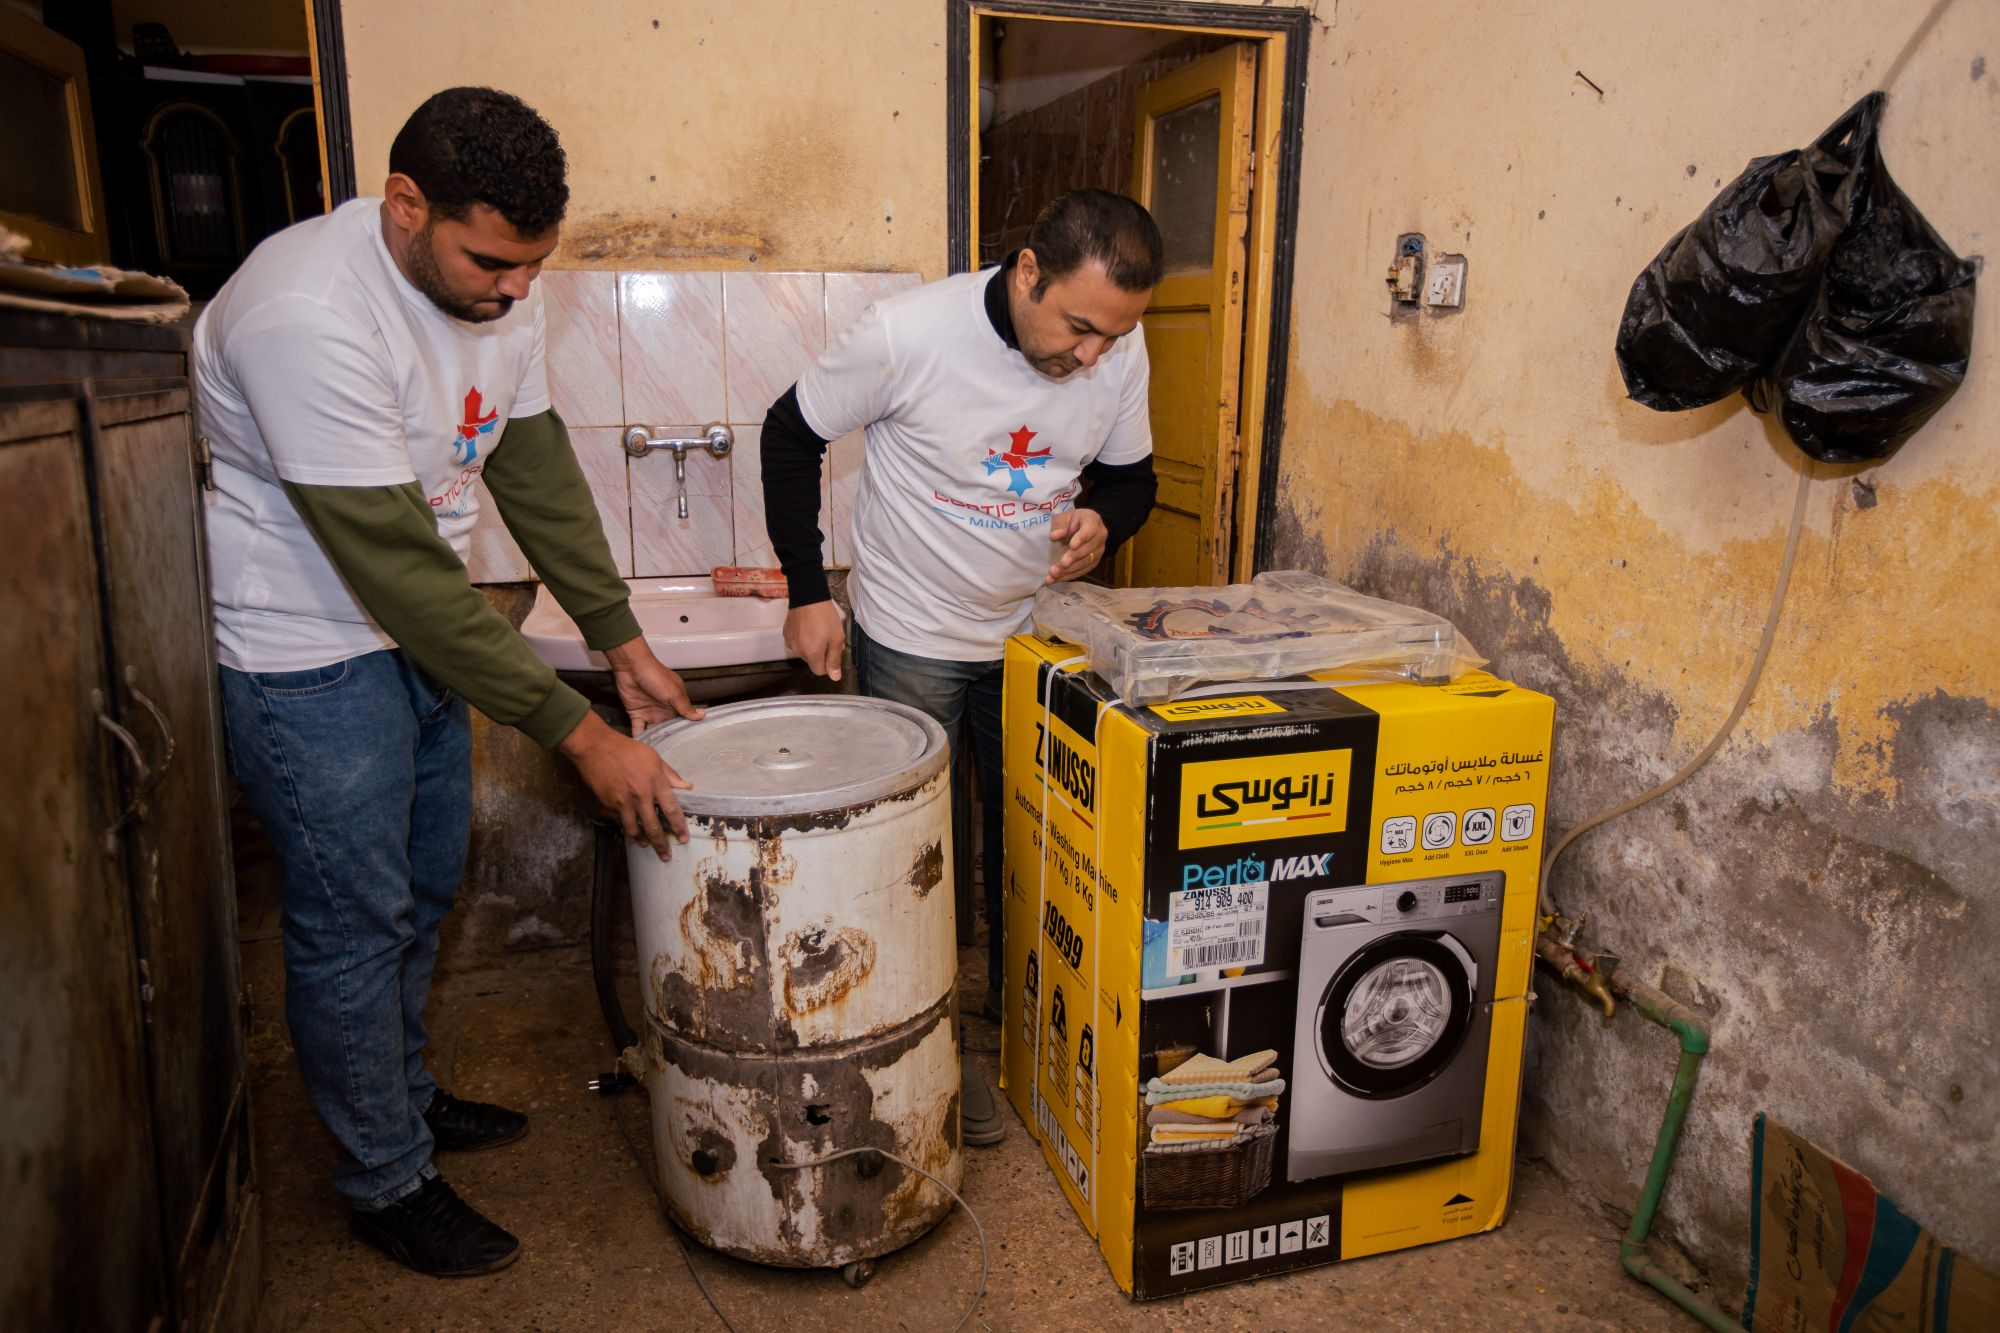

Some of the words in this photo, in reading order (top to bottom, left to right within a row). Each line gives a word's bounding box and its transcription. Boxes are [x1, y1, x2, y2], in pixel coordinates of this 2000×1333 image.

[969, 513, 1053, 532] MINISTRIE
[1452, 756, 1497, 772] ملابس
[1500, 751, 1544, 765] غسالة
[1385, 756, 1449, 776] أوتوماتك
[1476, 776, 1483, 785] ٧
[1493, 774, 1521, 785] كجم
[1524, 771, 1531, 781] ٦
[1395, 782, 1425, 795] كجم
[1427, 781, 1434, 790] ٨
[1444, 778, 1473, 790] كجم
[1015, 786, 1049, 833] Automatc
[1049, 819, 1080, 869] Washing
[1472, 821, 1487, 832] XXL
[1501, 845, 1512, 853] Add
[1513, 844, 1529, 852] Steam
[1379, 857, 1401, 867] Hygiene
[1402, 856, 1413, 864] Max
[1436, 852, 1450, 860] Cloth
[1033, 830, 1037, 846] 6
[1054, 850, 1058, 867] 7
[1059, 861, 1069, 887] Kg
[1075, 875, 1080, 894] 8
[1082, 882, 1094, 911] Kg
[1183, 857, 1265, 891] Perla
[1183, 887, 1231, 901] ZANUSSI
[1194, 896, 1211, 911] 914
[1216, 893, 1233, 908] 909
[1238, 891, 1254, 905] 400
[1043, 900, 1084, 970] 19999
[1028, 965, 1036, 988] 6
[1054, 997, 1062, 1021] 7
[1082, 1040, 1092, 1066] 8
